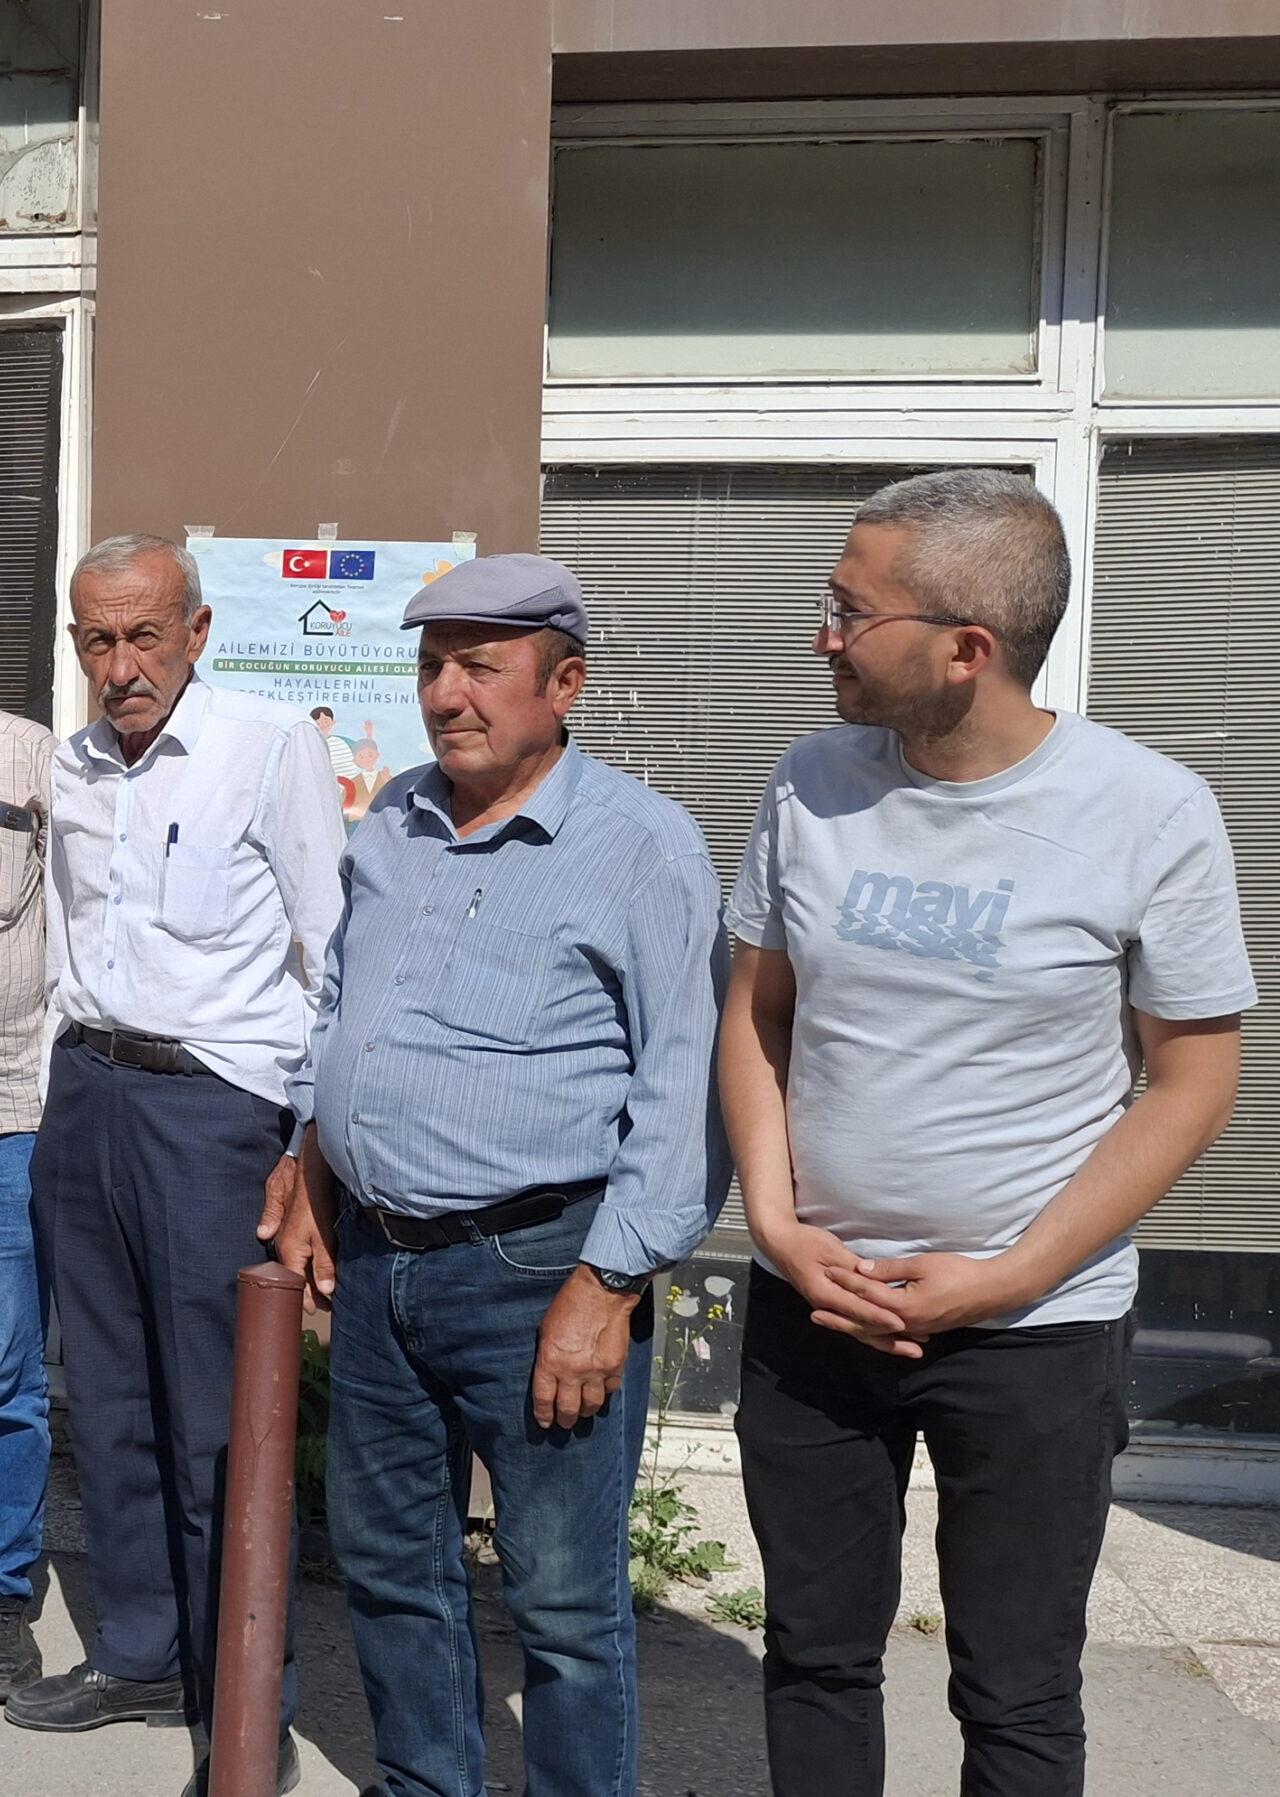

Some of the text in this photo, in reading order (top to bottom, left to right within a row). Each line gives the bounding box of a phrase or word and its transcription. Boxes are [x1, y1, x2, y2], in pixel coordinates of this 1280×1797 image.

[310, 621, 353, 630] KORUYUCU
[218, 641, 418, 658] AİLEMİZİ BÜYÜTÜYORU
[218, 660, 235, 669] BİR
[239, 661, 290, 671] ÇOCUĞUN
[295, 663, 351, 672] KORUYUCU
[356, 664, 389, 673] AİLESİ
[274, 678, 375, 690] HAYALLERİNİ
[835, 869, 1015, 942] mavi
